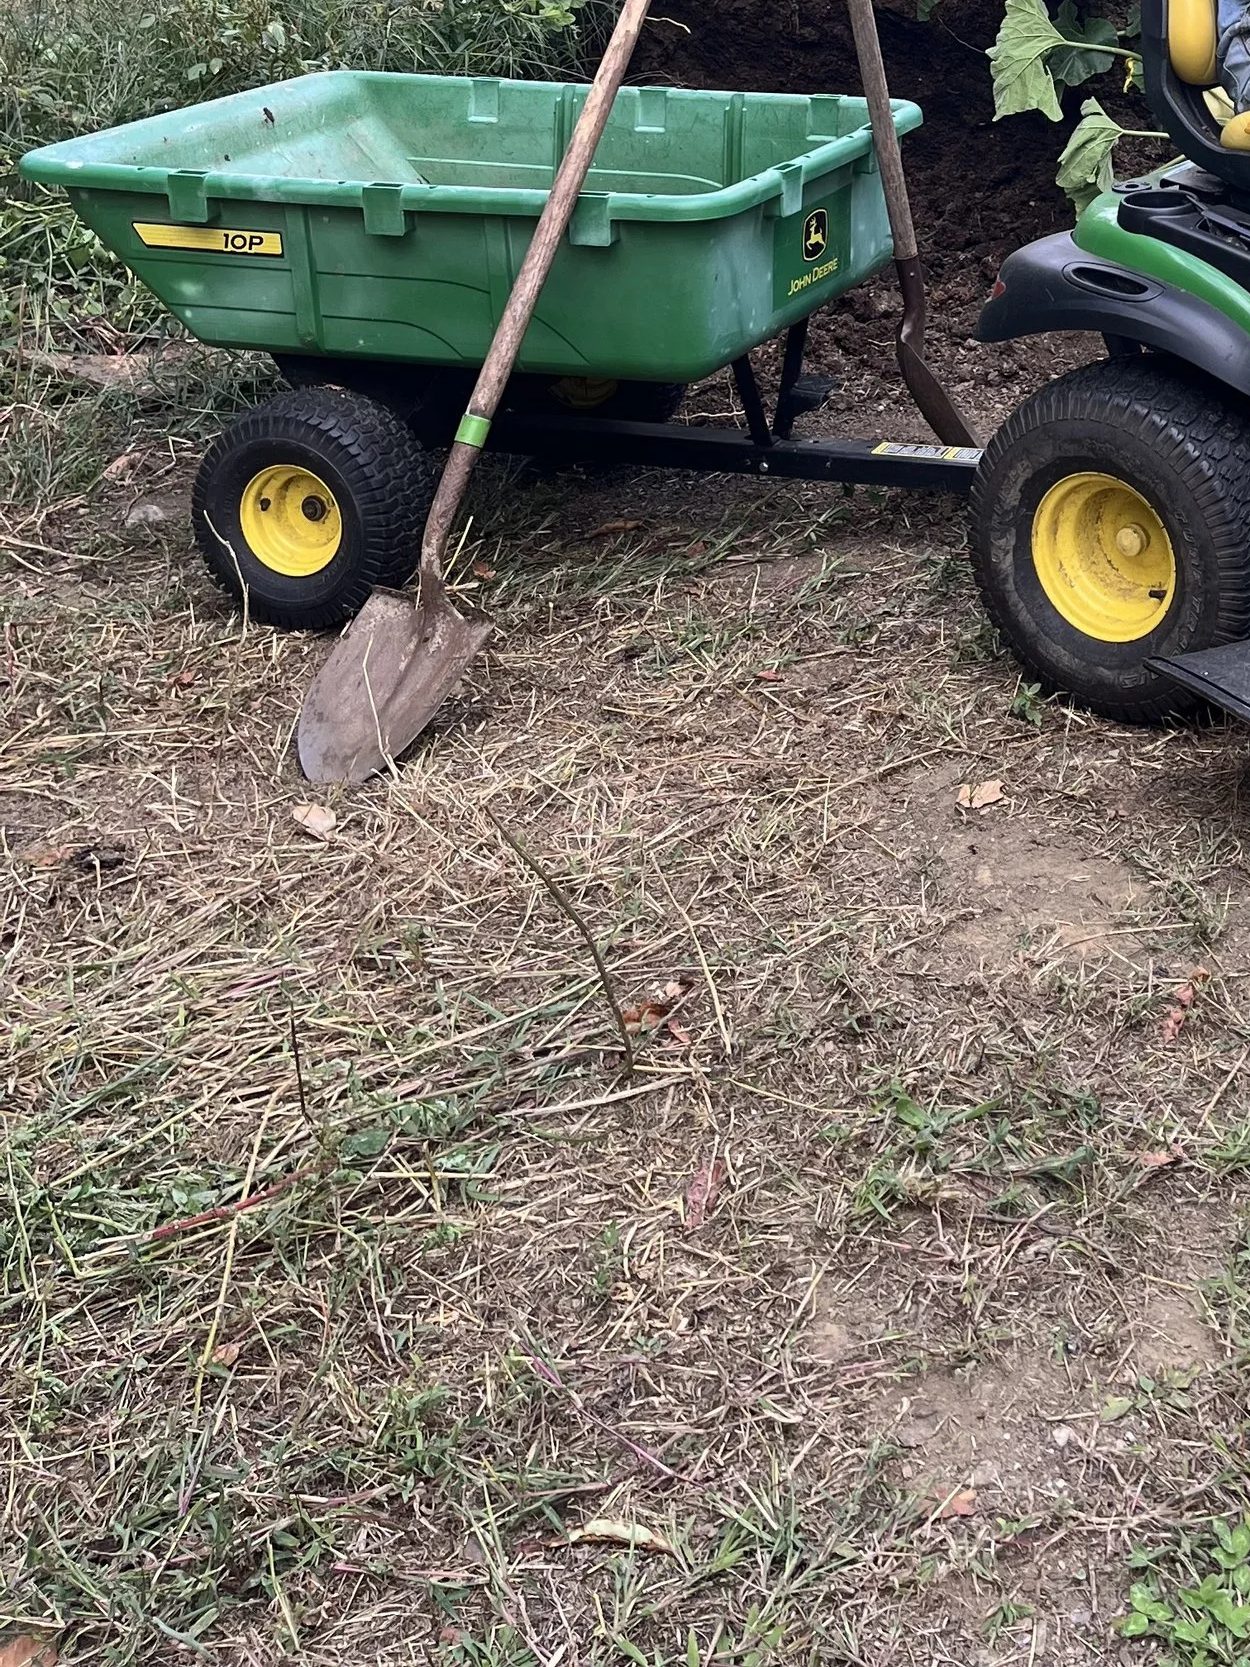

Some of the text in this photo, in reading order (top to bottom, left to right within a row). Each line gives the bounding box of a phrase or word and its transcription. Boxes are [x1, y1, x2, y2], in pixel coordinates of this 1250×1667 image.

[223, 233, 264, 251] 10P
[788, 257, 839, 296] JOHN DEERE
